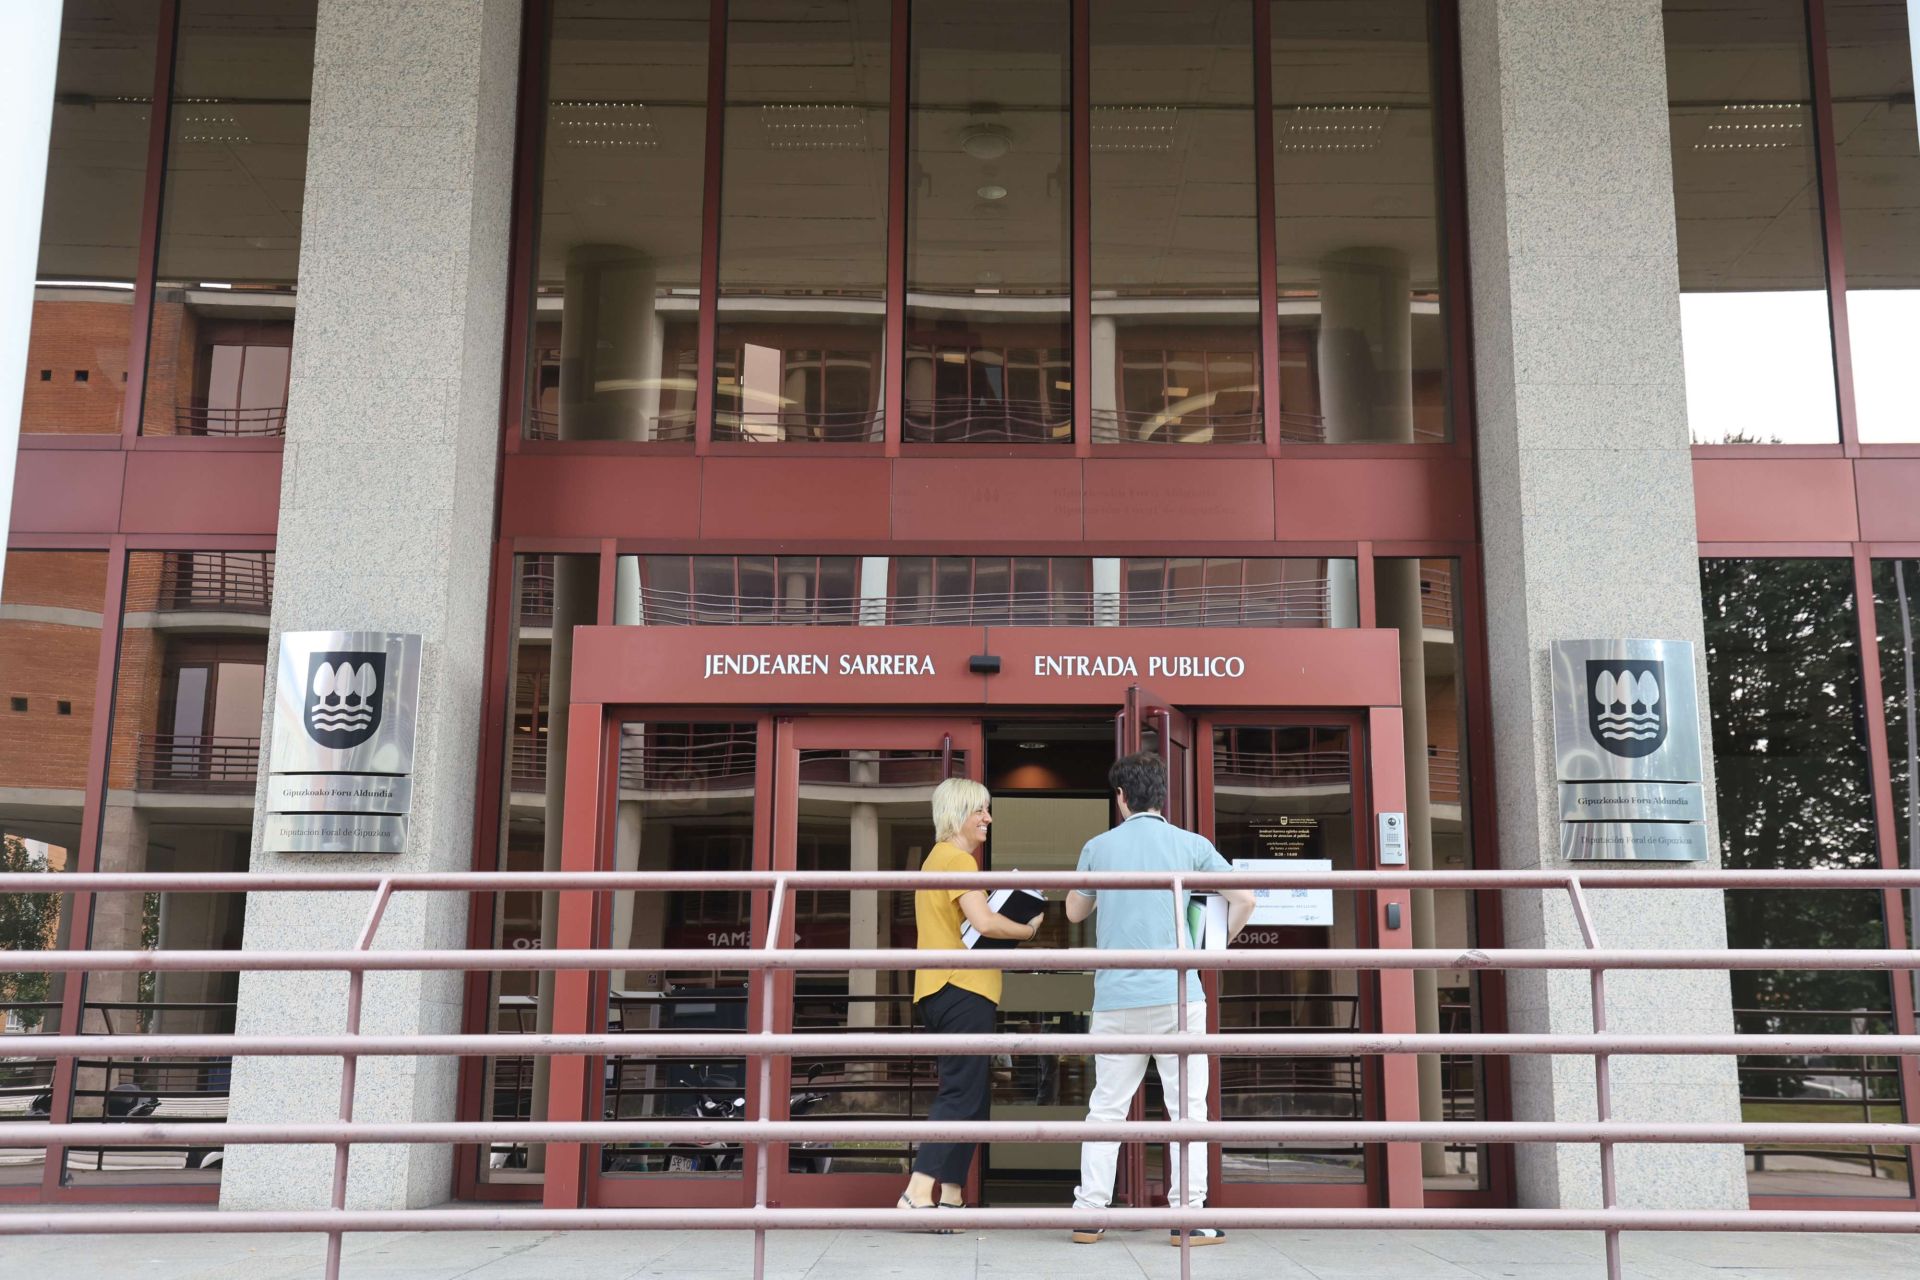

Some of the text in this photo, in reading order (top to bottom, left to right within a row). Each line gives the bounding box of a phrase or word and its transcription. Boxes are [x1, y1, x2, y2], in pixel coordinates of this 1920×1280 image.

[704, 654, 936, 679] JENDEAREN SARRERA
[1034, 655, 1245, 677] ENTRADA PUBLICO
[282, 788, 393, 798] Gipuzkoako Foru Aldundia
[1577, 796, 1689, 806] Gipuzkoako Foru Aldundia
[321, 828, 341, 837] Foral
[342, 828, 352, 837] de
[1647, 836, 1656, 845] de
